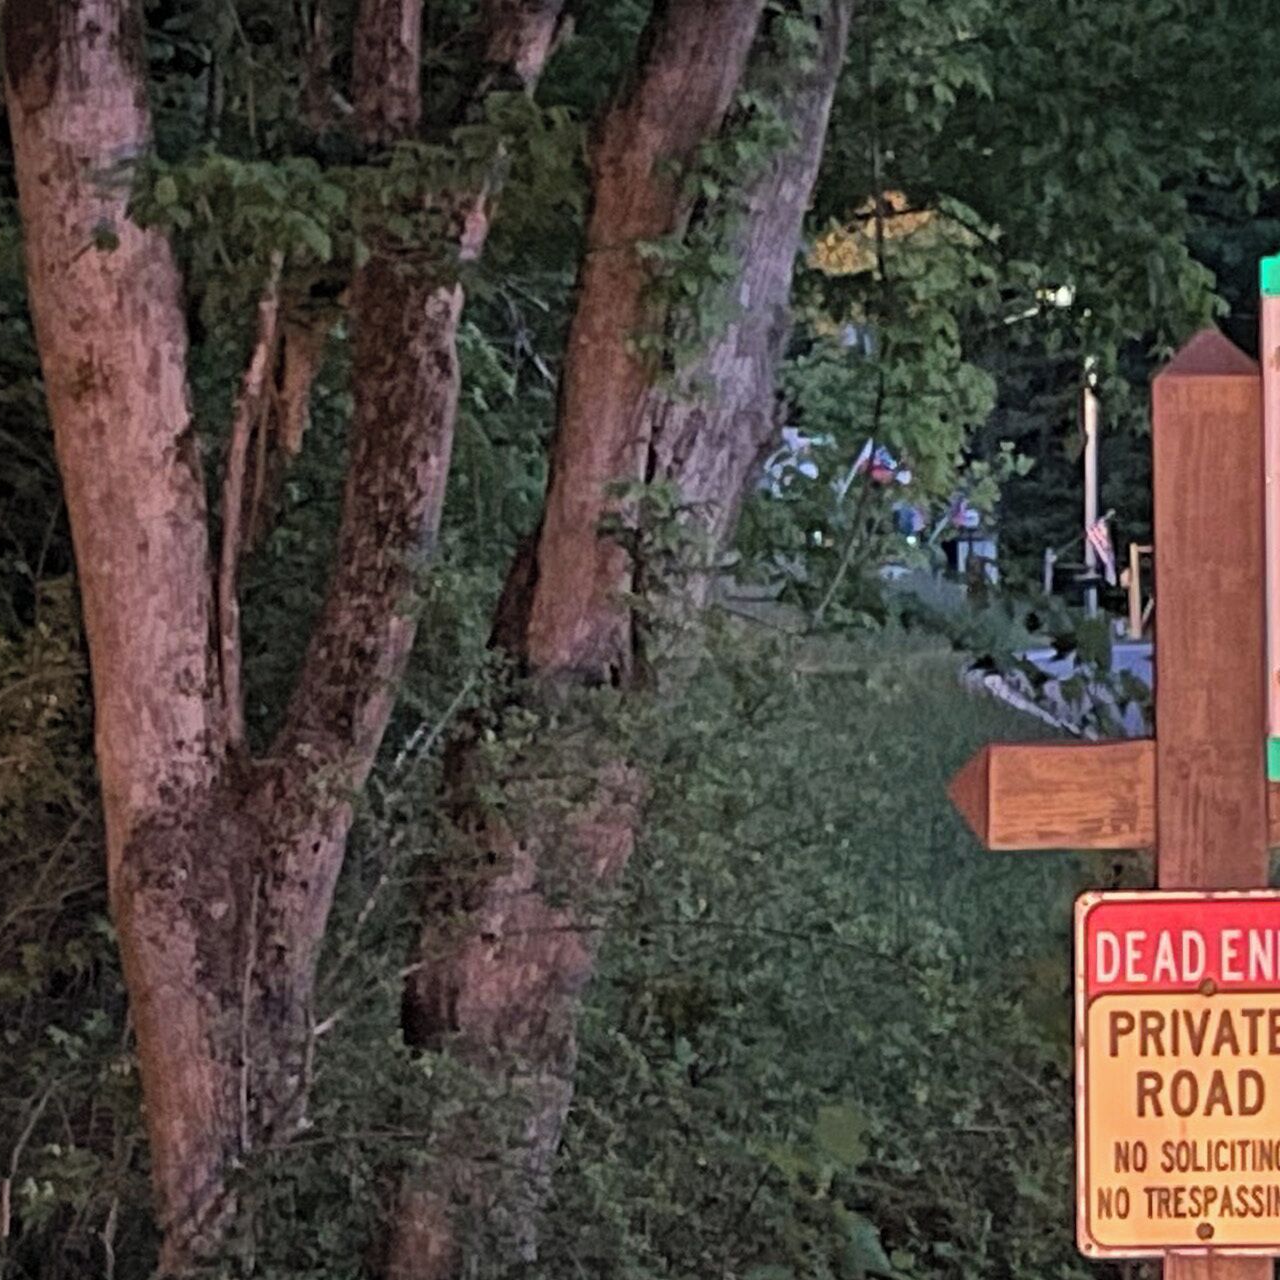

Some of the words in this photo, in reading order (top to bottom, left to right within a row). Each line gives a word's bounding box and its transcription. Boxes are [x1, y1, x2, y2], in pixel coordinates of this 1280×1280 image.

[1095, 929, 1207, 984] DEAD
[1136, 1068, 1265, 1118] ROAD
[1114, 1141, 1148, 1173] NO
[1097, 1187, 1130, 1220] NO
